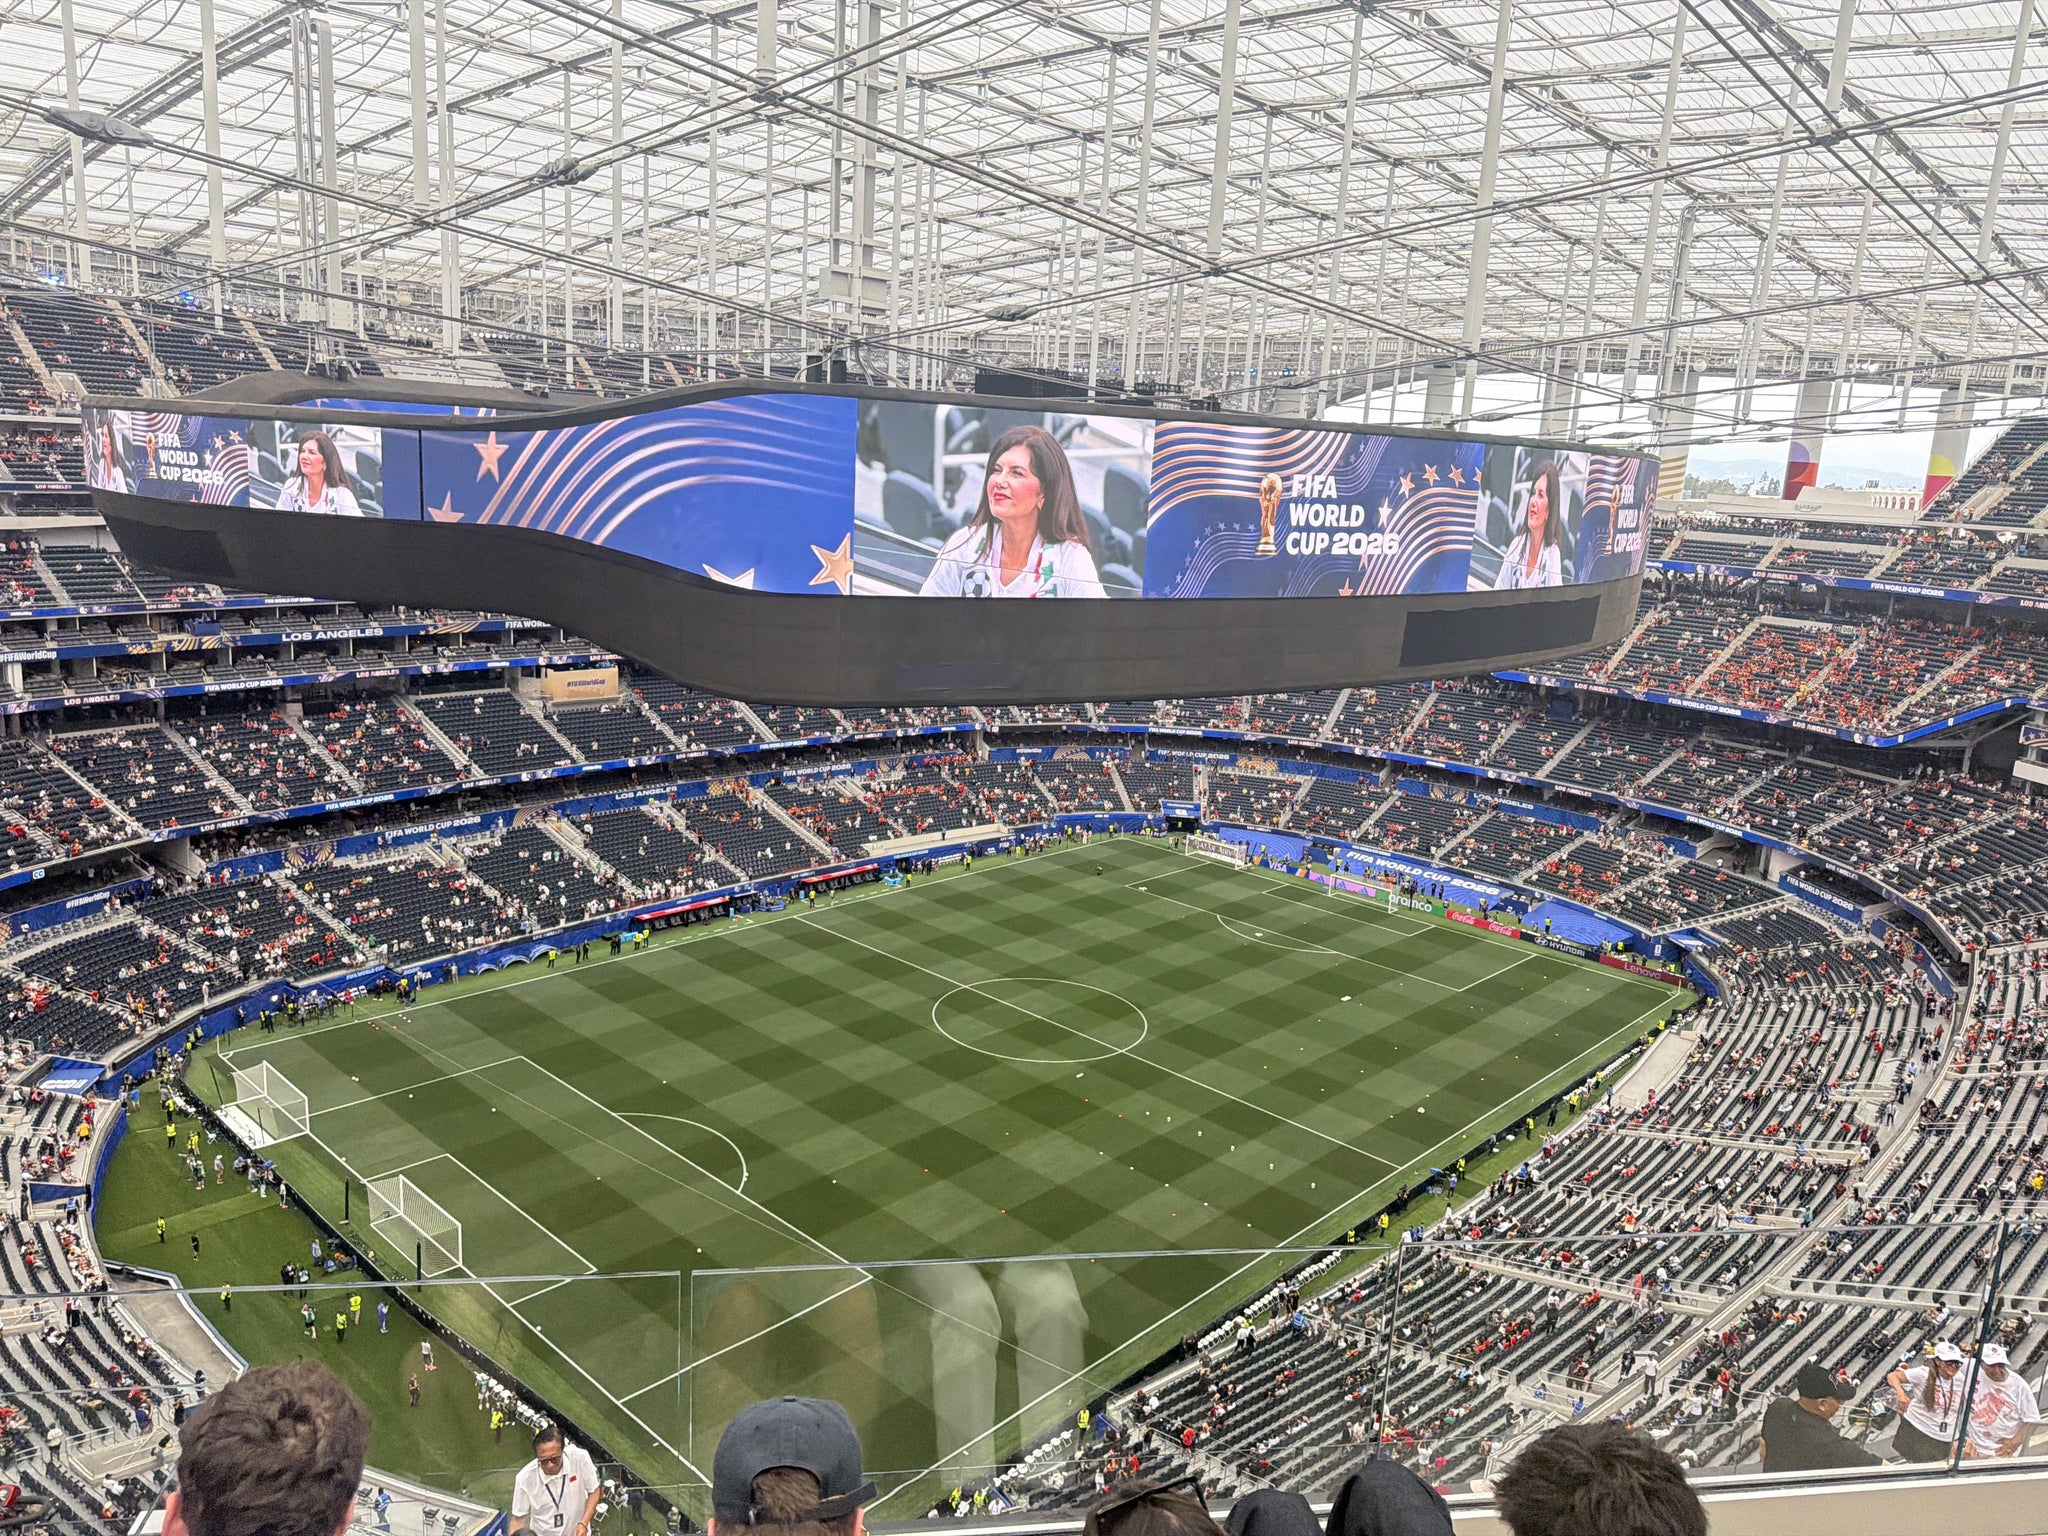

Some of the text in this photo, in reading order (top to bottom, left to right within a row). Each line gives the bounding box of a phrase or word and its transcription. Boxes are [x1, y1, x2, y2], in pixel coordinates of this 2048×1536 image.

[158, 433, 181, 448] FIFA
[159, 449, 198, 466] WORLD
[160, 466, 224, 485] CUP 2026
[1291, 474, 1337, 498] FIFA
[1621, 485, 1634, 504] FIFA
[1289, 503, 1365, 528] WORLD
[1618, 509, 1638, 529] WORLD
[1286, 532, 1400, 555] CUP 2026
[1614, 533, 1628, 554] CUP
[1767, 572, 1798, 582] ANGELES
[1885, 584, 1907, 592] WORLD
[2020, 600, 2034, 608] LOS
[282, 628, 384, 642] LOS ANGELES
[83, 695, 120, 704] ANGELES
[1682, 700, 1705, 709] WORLD
[1705, 704, 1718, 712] CUP
[1718, 706, 1742, 716] 2026
[1792, 721, 1837, 736] LOS ANGELES
[796, 768, 818, 776] WORLD
[615, 786, 678, 800] LOS ANGELES
[340, 800, 361, 808] WORLD
[374, 794, 394, 802] 2026
[200, 824, 216, 832] LOS
[385, 816, 482, 838] FIFA WORLD CUP 2026
[1269, 860, 1287, 872] VISA
[1346, 851, 1501, 896] FIFA WORLD CUP 2026
[1786, 876, 1854, 911] FIFA WORLD CUP 2026
[1388, 893, 1432, 912] aramco
[1452, 912, 1475, 925] Coca-Cola
[1488, 922, 1513, 936] Coca-Cola
[1550, 942, 1586, 958] HYUNDAI
[358, 968, 374, 977] WORLD
[375, 965, 386, 974] CUP
[1624, 962, 1661, 980] Lenovo
